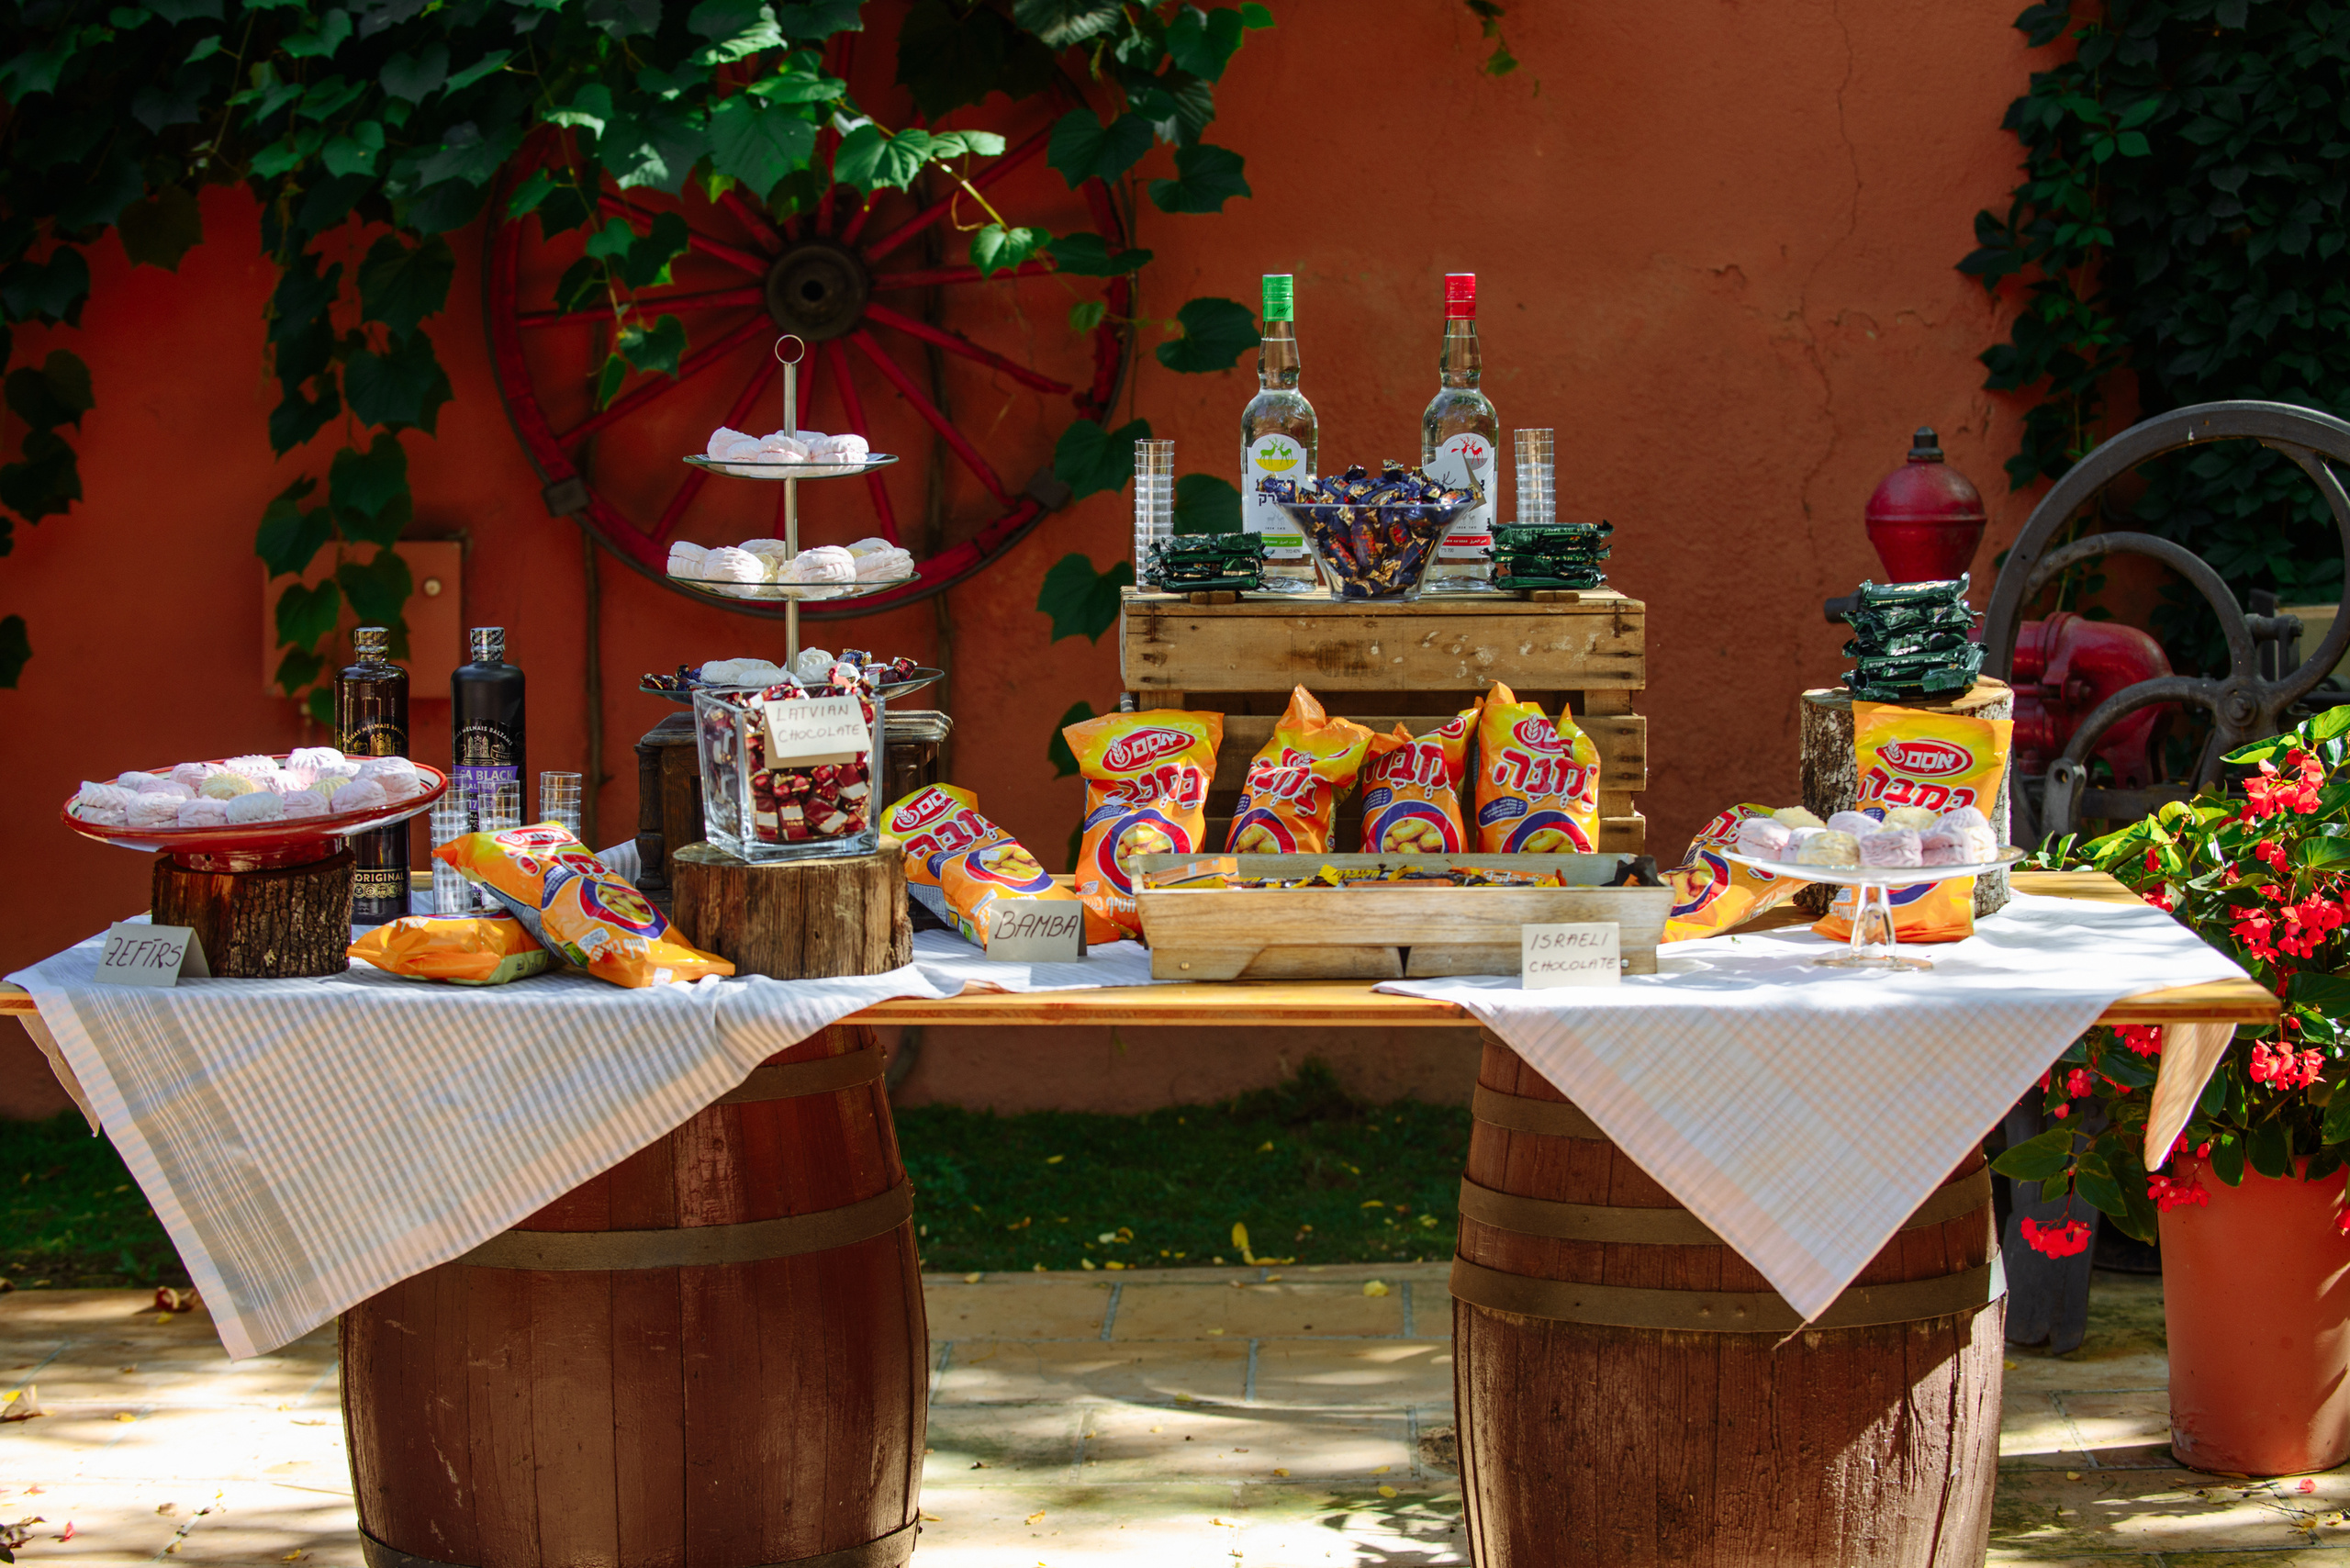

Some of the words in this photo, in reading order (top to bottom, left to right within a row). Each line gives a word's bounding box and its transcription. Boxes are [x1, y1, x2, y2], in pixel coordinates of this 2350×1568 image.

[777, 704, 849, 722] LATVIAN
[361, 722, 390, 733] MELNAIS
[778, 724, 860, 743] CHOCOLATE
[1132, 733, 1177, 759] אסם
[1904, 751, 1955, 771] אסם
[476, 769, 514, 780] BLACK
[355, 872, 405, 882] ORIGINAL
[994, 911, 1079, 940] BAMBA
[1530, 933, 1608, 950] ISRAELI
[106, 936, 183, 969] ZEFĪRS
[1528, 958, 1616, 972] CHOCOLATE
